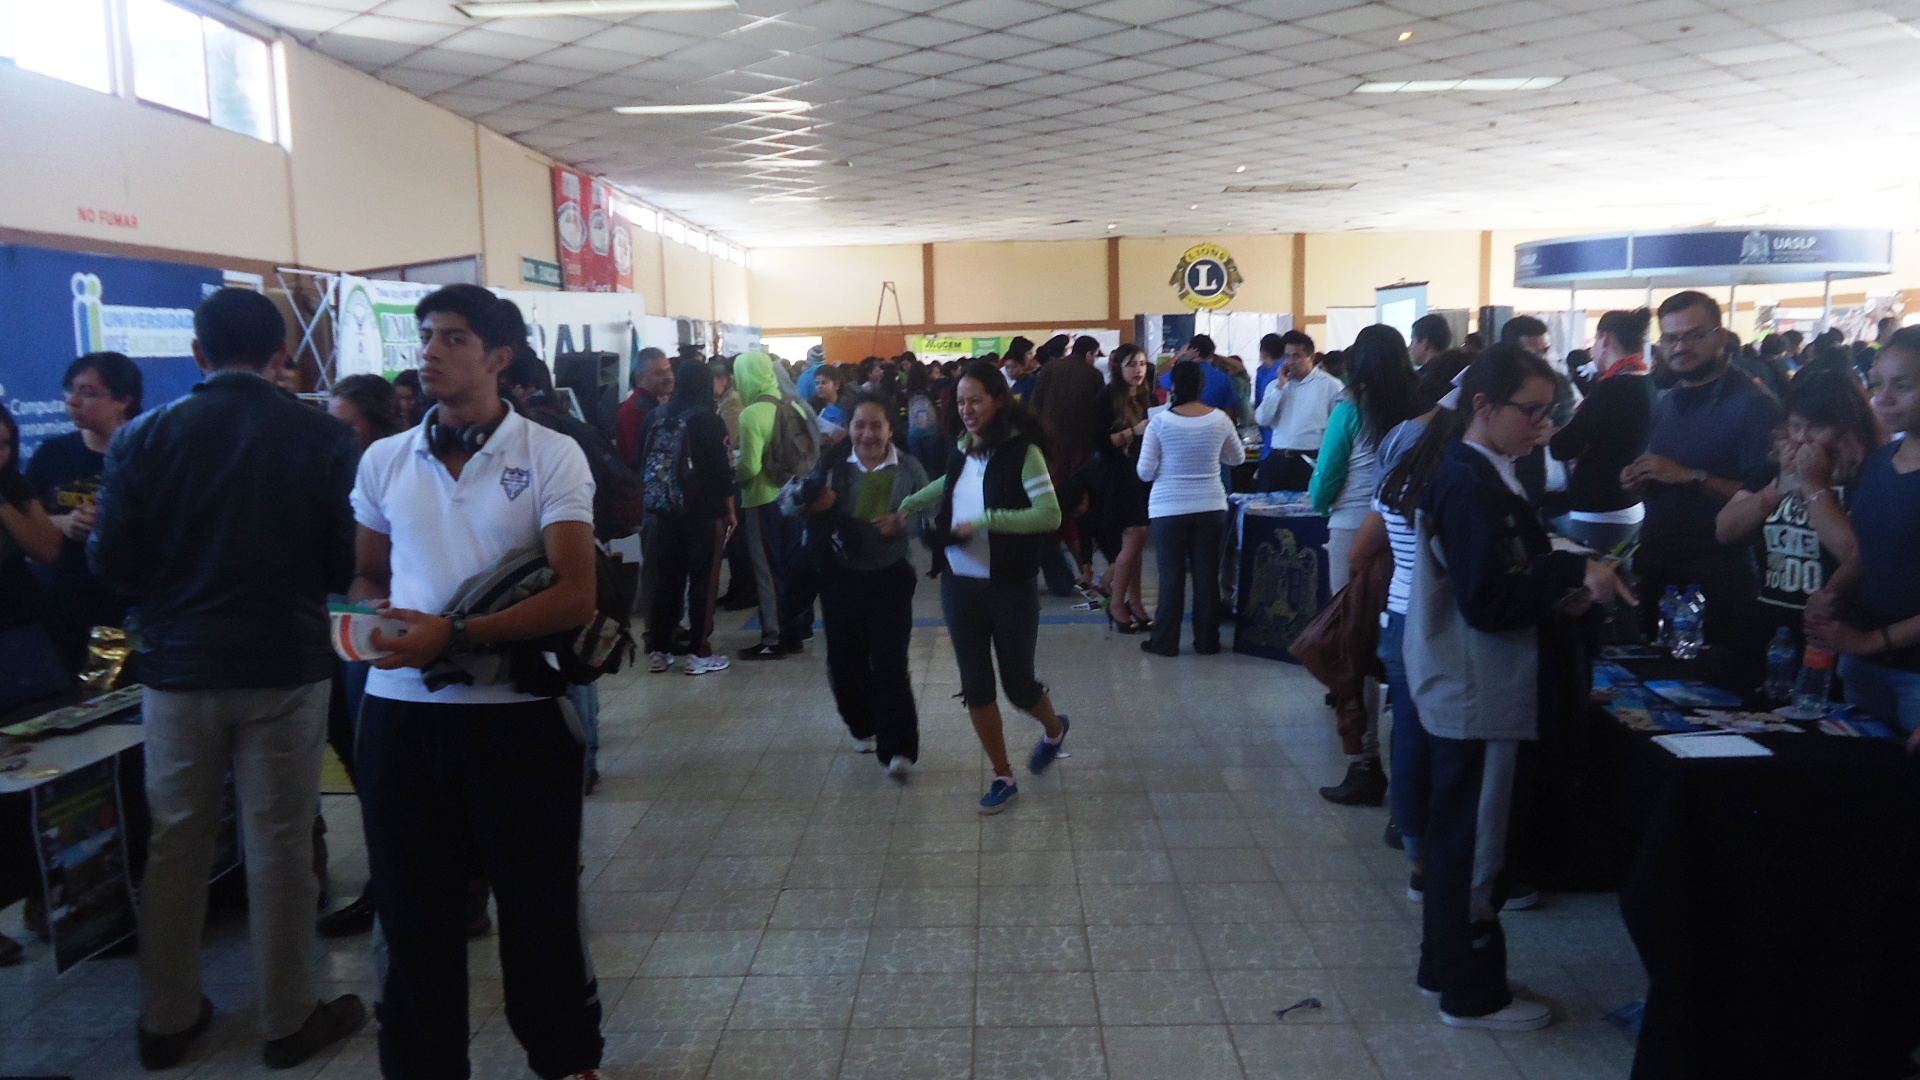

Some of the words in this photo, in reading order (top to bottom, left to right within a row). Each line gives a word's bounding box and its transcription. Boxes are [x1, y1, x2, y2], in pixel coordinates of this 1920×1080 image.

[77, 206, 95, 223] NO
[99, 209, 139, 229] FUMAR
[1773, 236, 1817, 250] UASLP
[1194, 265, 1218, 291] L
